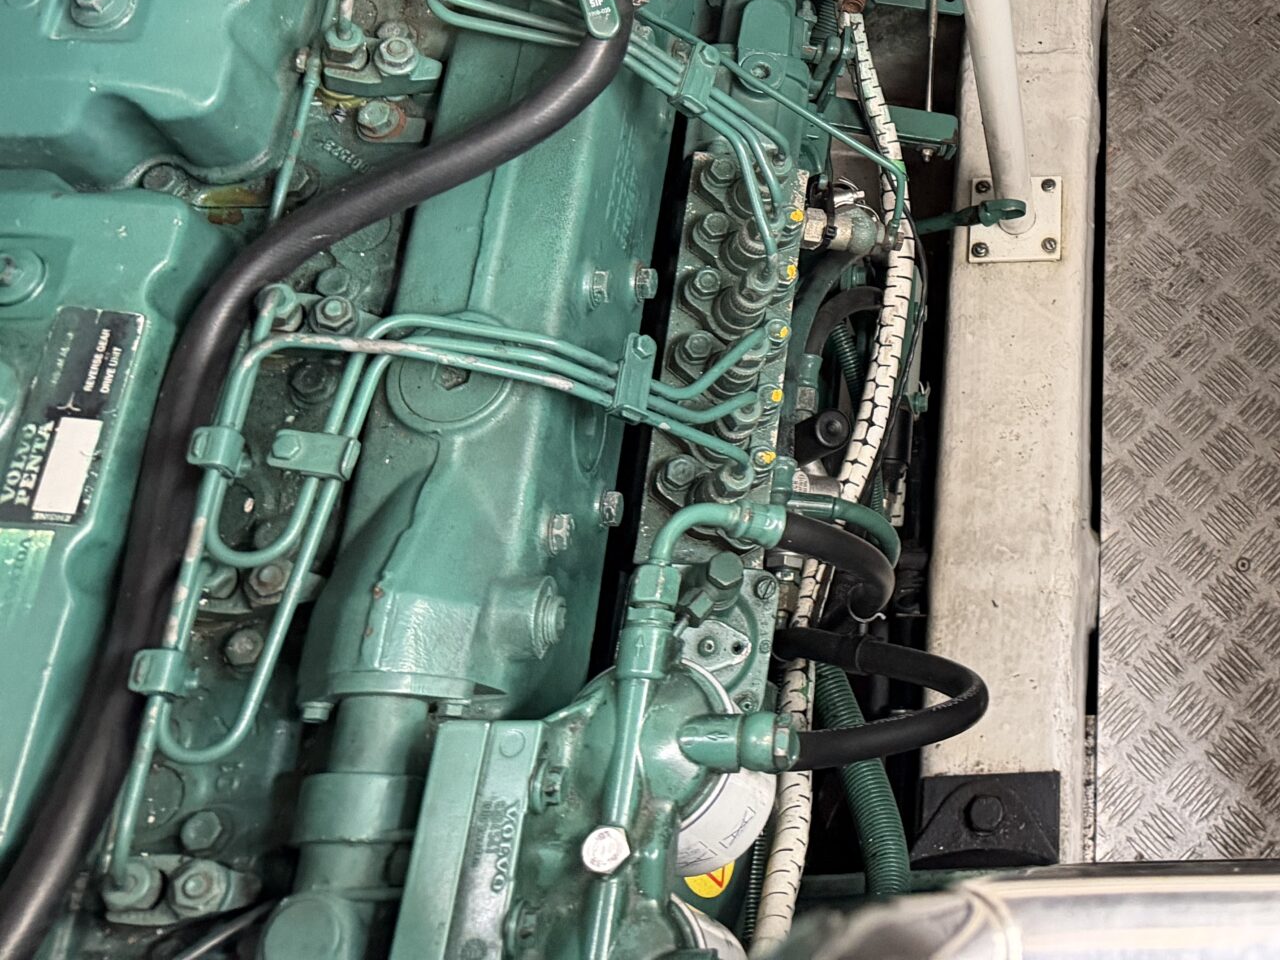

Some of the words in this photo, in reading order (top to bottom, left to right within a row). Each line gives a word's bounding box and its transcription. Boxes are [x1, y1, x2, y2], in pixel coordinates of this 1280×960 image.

[83, 353, 104, 392] REVERSE
[96, 328, 111, 352] GEAR
[99, 367, 116, 394] DRIVE
[108, 346, 122, 367] UNIT
[0, 423, 37, 503] VOLVO
[14, 420, 56, 506] PENTA
[490, 799, 521, 893] VOLVO
